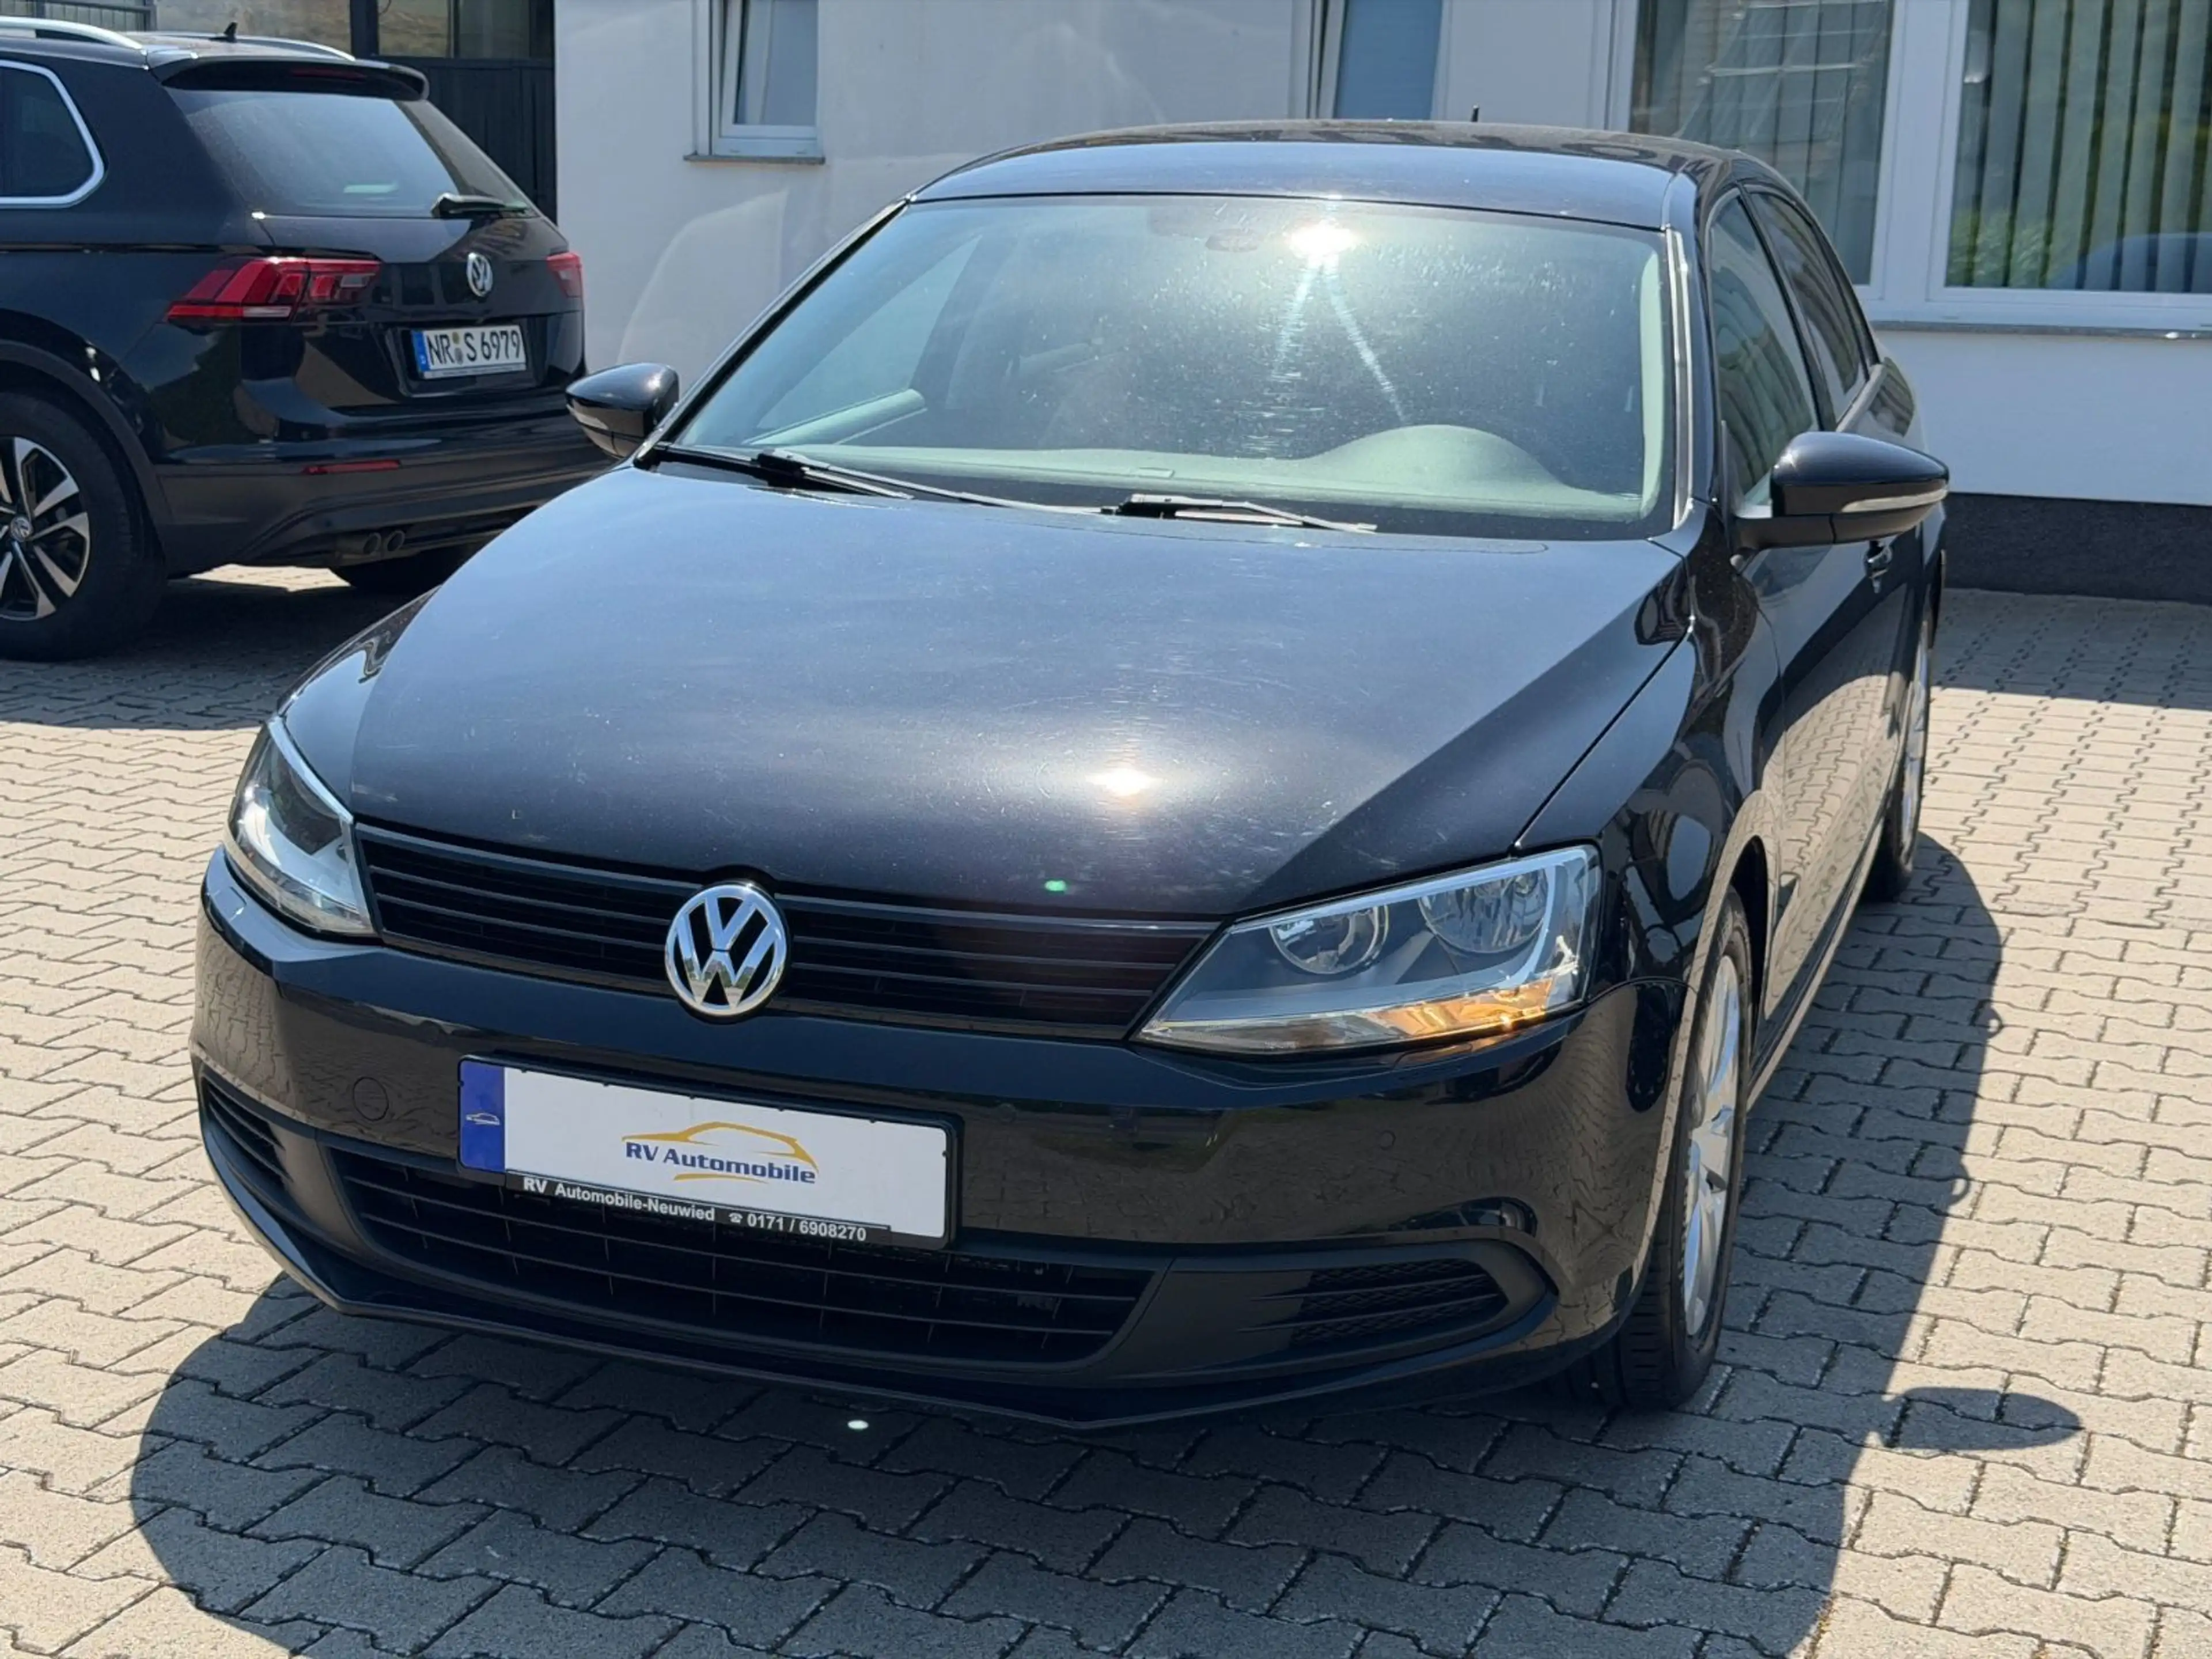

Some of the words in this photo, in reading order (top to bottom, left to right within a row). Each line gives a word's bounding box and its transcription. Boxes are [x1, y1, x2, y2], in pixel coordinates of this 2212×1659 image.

[427, 334, 454, 365] NR
[464, 332, 478, 362] S
[480, 329, 520, 361] 6979
[665, 884, 787, 1016] VW
[626, 1142, 659, 1161] RV
[663, 1148, 816, 1184] Automobile
[523, 1177, 547, 1194] RV
[555, 1183, 716, 1221] Automobile-Neuwied
[747, 1213, 784, 1232] 0171
[799, 1220, 867, 1241] 6908270
